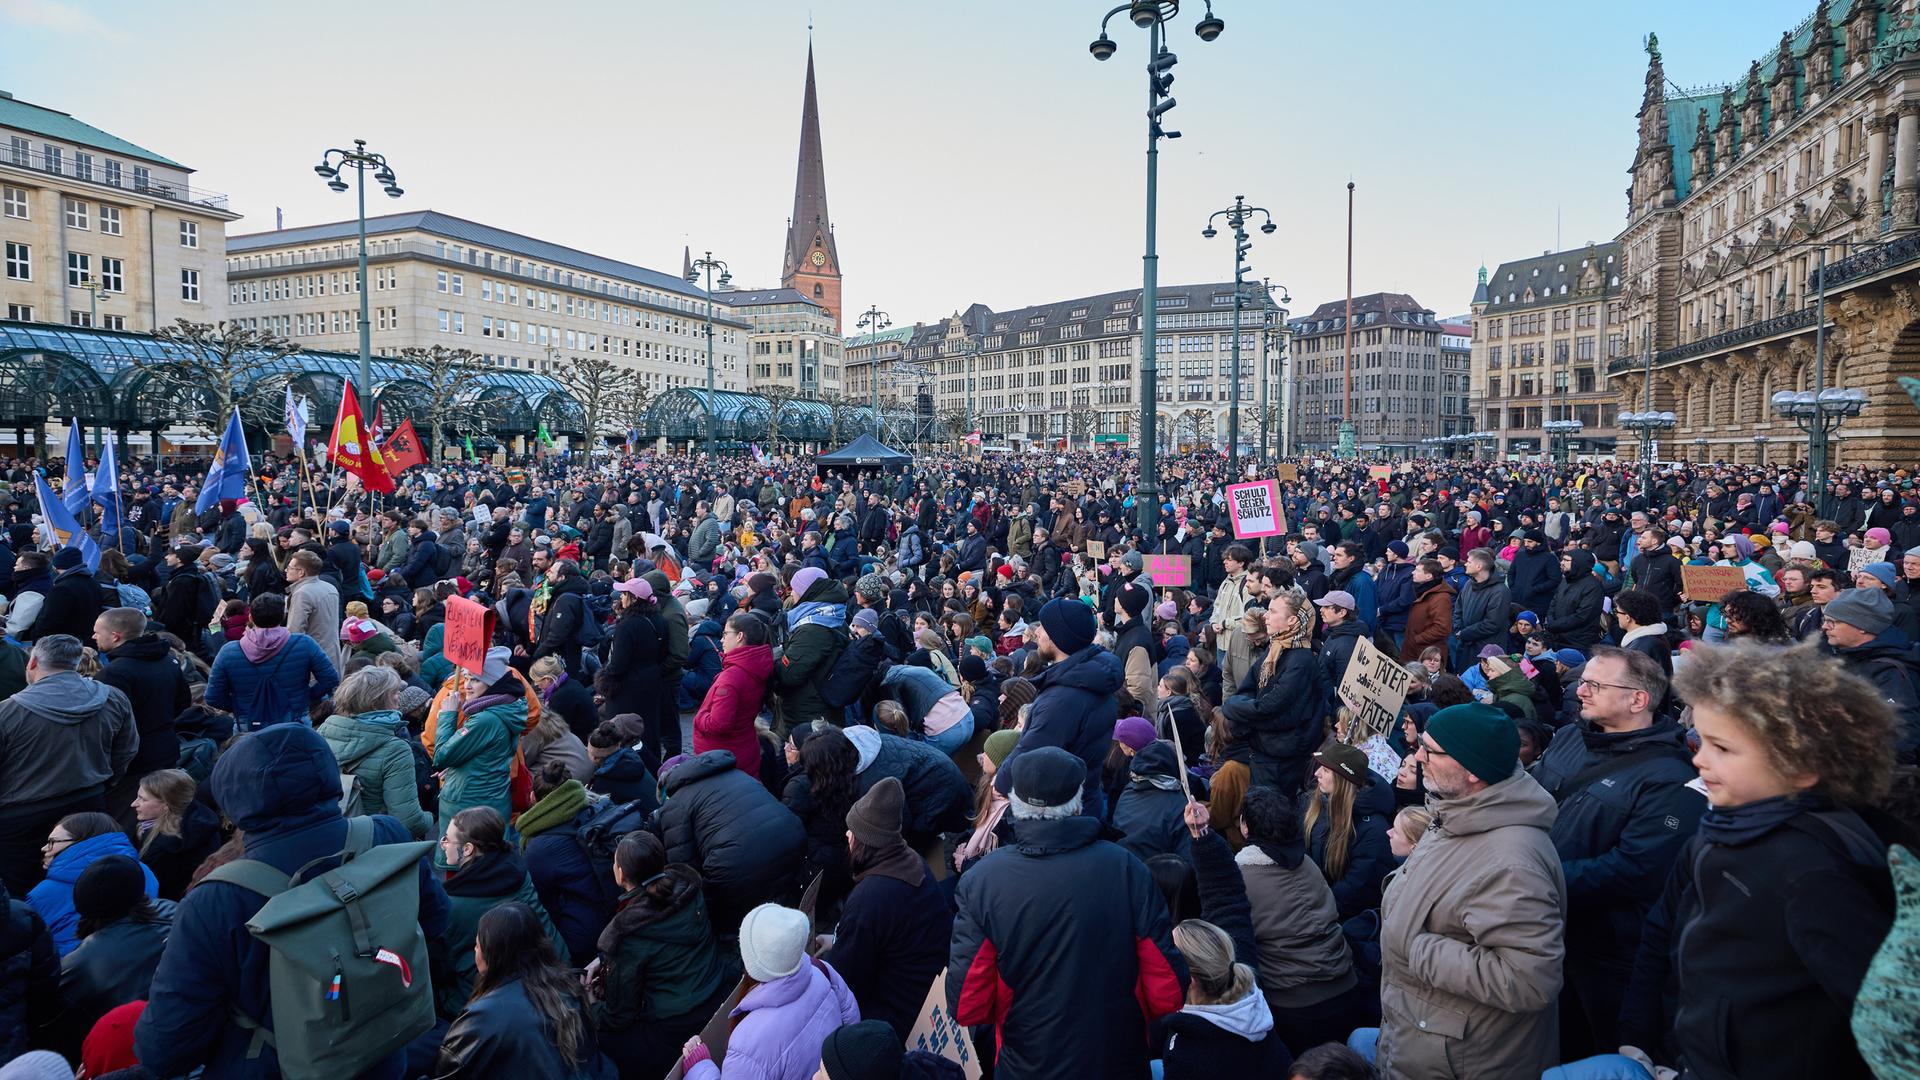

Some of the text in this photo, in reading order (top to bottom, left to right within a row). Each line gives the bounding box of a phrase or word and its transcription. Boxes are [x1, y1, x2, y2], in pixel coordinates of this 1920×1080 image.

[337, 454, 355, 466] SIND
[1234, 487, 1267, 500] SCHULD
[1239, 497, 1266, 509] GEGEN
[1237, 506, 1272, 520] SCHUTZ
[1151, 555, 1188, 572] ALL
[1357, 643, 1408, 697] Wer TÄTER
[1356, 672, 1382, 697] schützt
[1360, 695, 1394, 738] TÄTER
